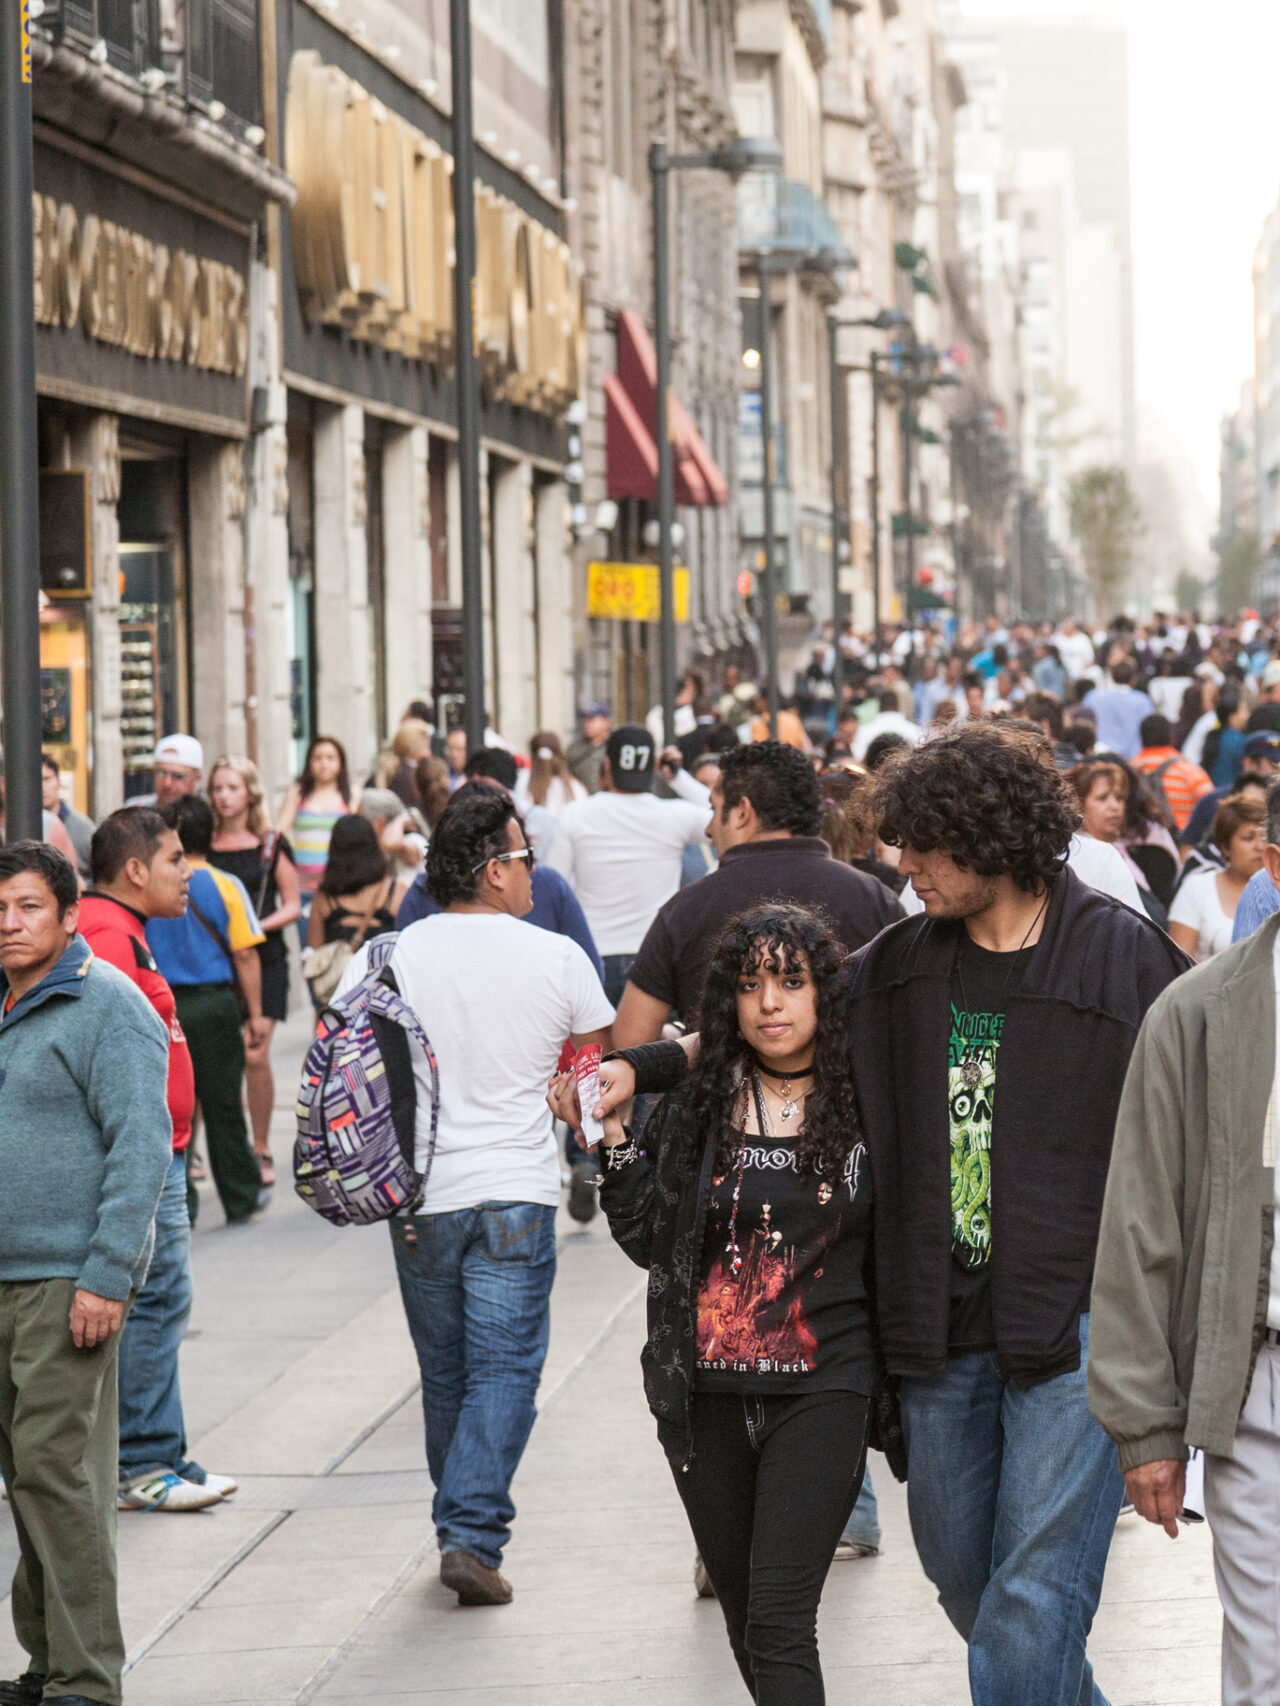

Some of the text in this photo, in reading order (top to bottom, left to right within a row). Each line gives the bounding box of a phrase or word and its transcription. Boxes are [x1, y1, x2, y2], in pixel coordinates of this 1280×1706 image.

[620, 744, 650, 771] 87
[733, 1359, 747, 1372] in
[757, 1358, 809, 1375] Black
